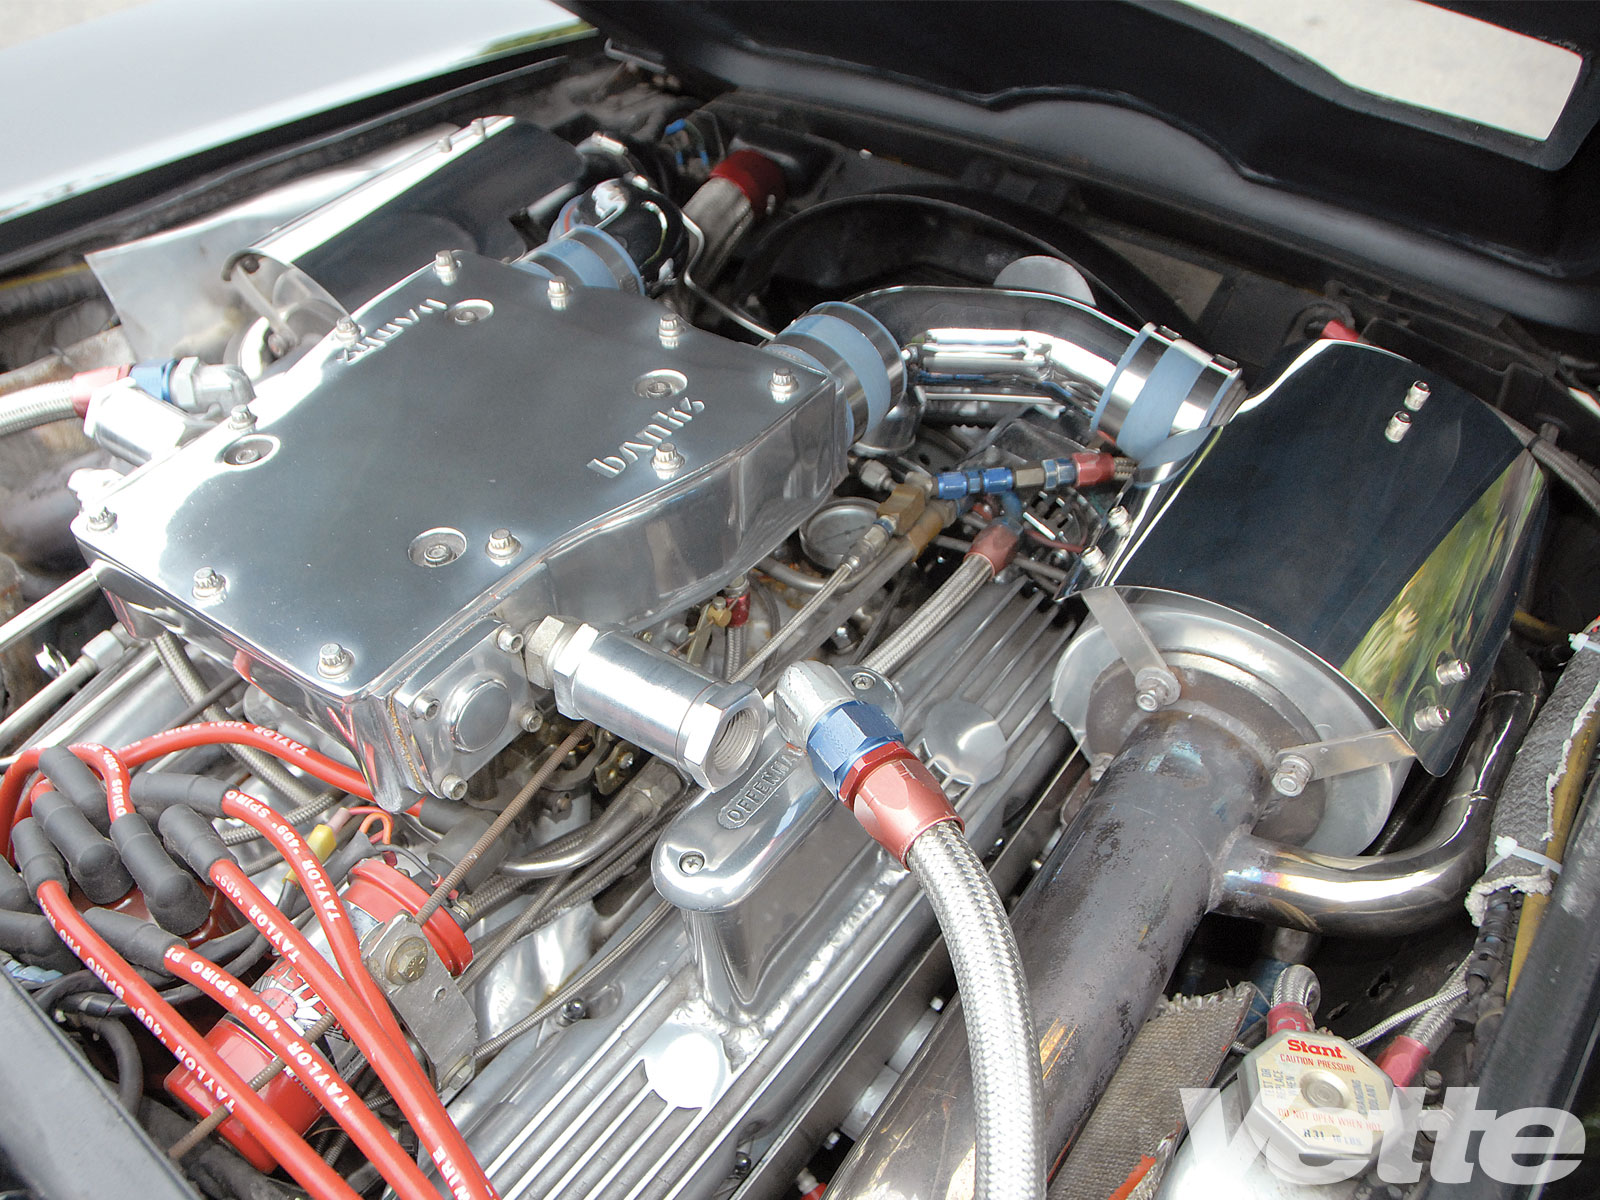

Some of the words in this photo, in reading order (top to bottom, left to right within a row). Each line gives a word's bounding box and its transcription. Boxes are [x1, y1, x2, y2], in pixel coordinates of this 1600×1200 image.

[587, 397, 705, 478] banks
[253, 726, 309, 756] TAYLOR
[111, 779, 128, 817] SPIRO
[224, 789, 272, 819] SPIRO
[301, 858, 342, 923] TAYLOR
[248, 904, 301, 964] TAYLOR
[190, 960, 240, 999] SPIRO
[1280, 1053, 1314, 1066] CAUTION
[1317, 1059, 1357, 1074] PRESSURE
[1287, 1038, 1344, 1059] Stant
[173, 1045, 236, 1114] TAYLOR
[286, 1041, 351, 1109] TAYLOR
[1313, 1111, 1335, 1125] OPEN
[1337, 1116, 1363, 1129] WHEN
